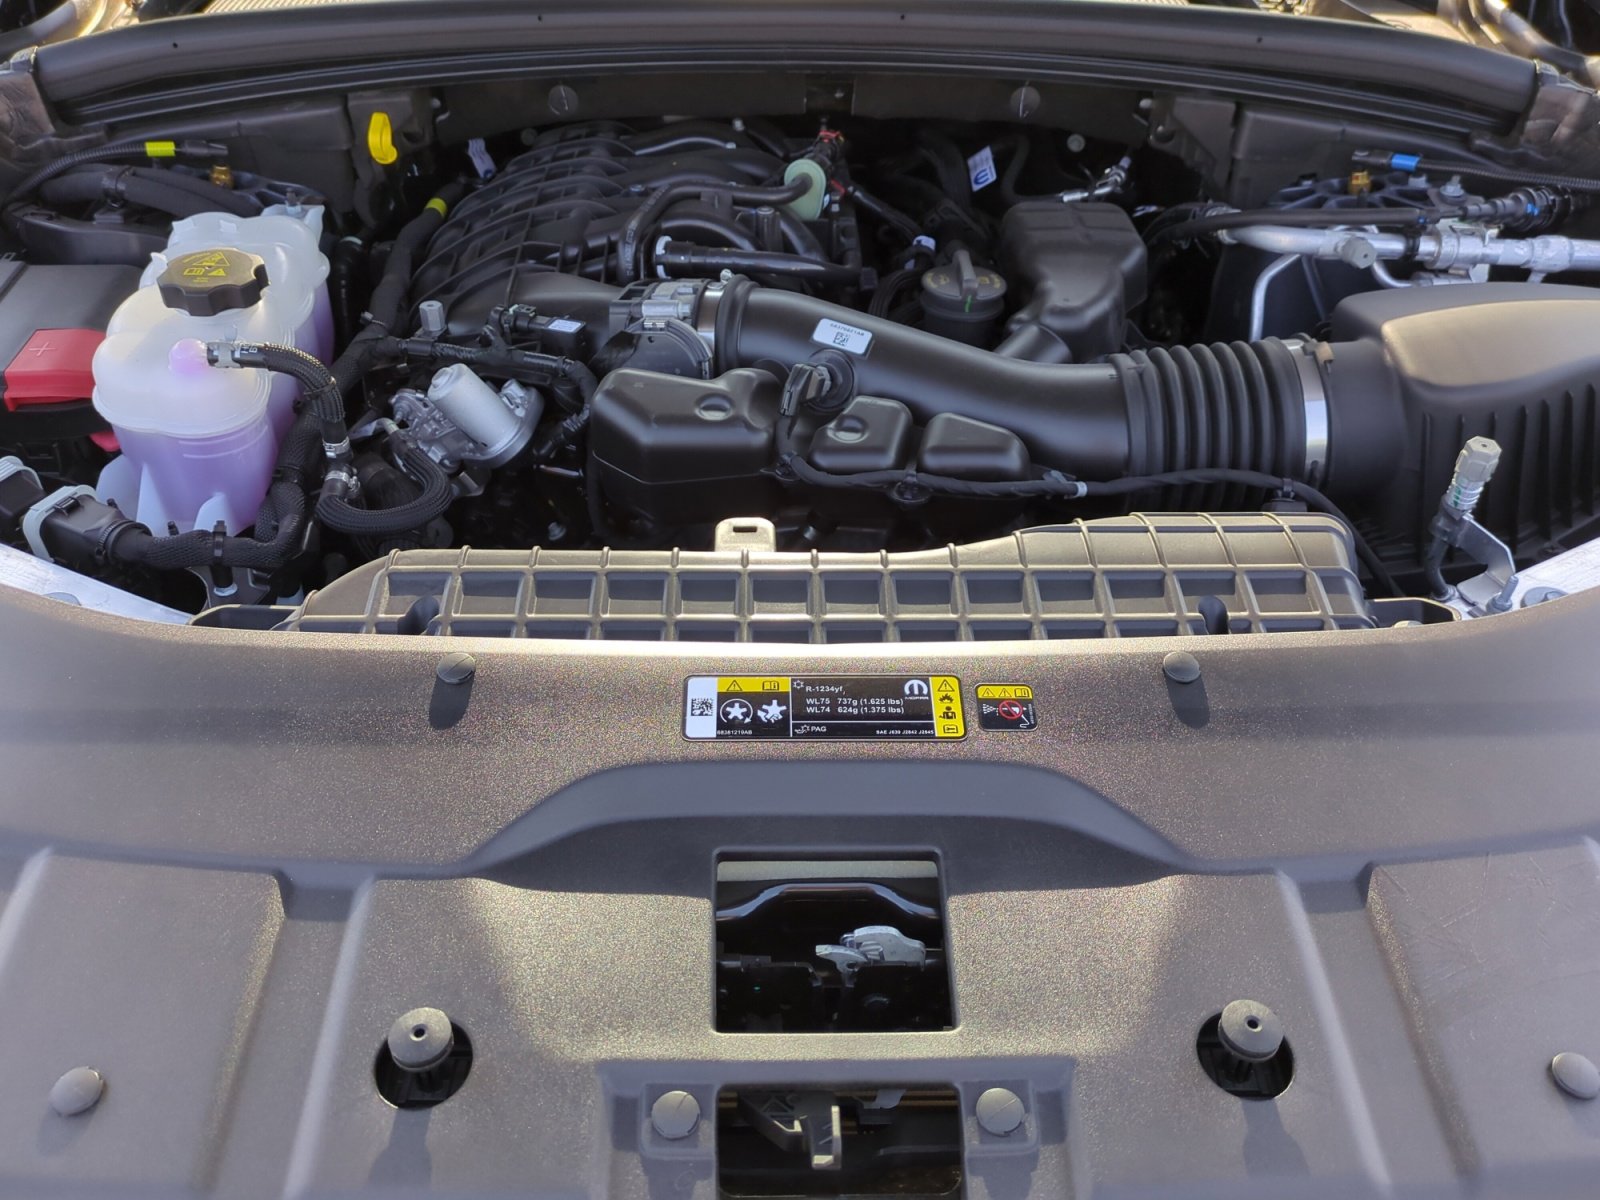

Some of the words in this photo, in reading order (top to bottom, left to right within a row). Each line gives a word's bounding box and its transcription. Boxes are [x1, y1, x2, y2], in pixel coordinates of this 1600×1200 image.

[806, 697, 831, 705] WL75
[837, 697, 858, 706] 737g
[860, 697, 886, 706] (1.625
[887, 697, 904, 706] lbs)
[837, 706, 859, 714] 624g
[860, 706, 887, 715] (1.375
[888, 706, 905, 715] lbs)
